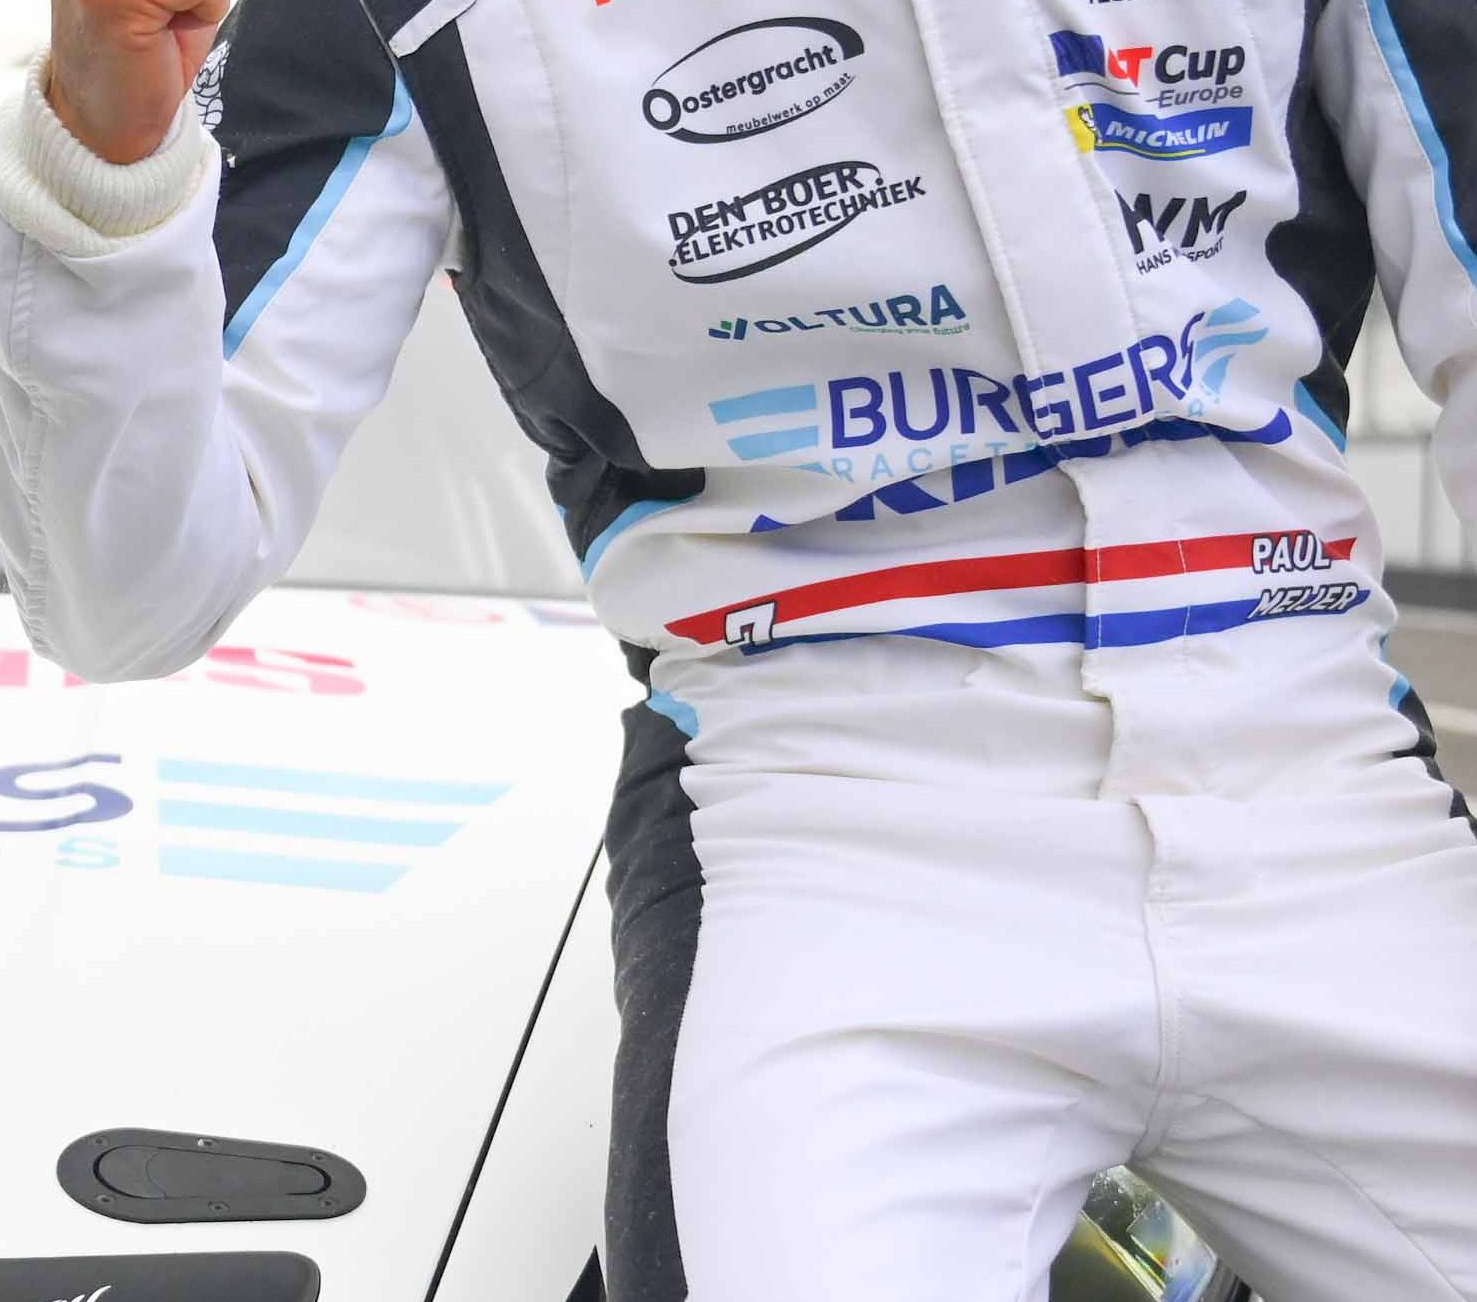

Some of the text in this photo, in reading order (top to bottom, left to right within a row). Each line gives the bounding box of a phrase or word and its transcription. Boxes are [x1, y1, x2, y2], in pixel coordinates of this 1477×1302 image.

[642, 43, 837, 131] Oostergracht
[1155, 45, 1246, 87] Cup
[725, 72, 852, 135] meubelwerk op maat
[1157, 83, 1243, 109] Europe
[667, 166, 865, 242] DEN BOER
[1135, 248, 1172, 276] HANS
[826, 310, 1206, 454] BURGERS
[1251, 531, 1332, 575] PAUL
[1247, 582, 1360, 620] MEIJER
